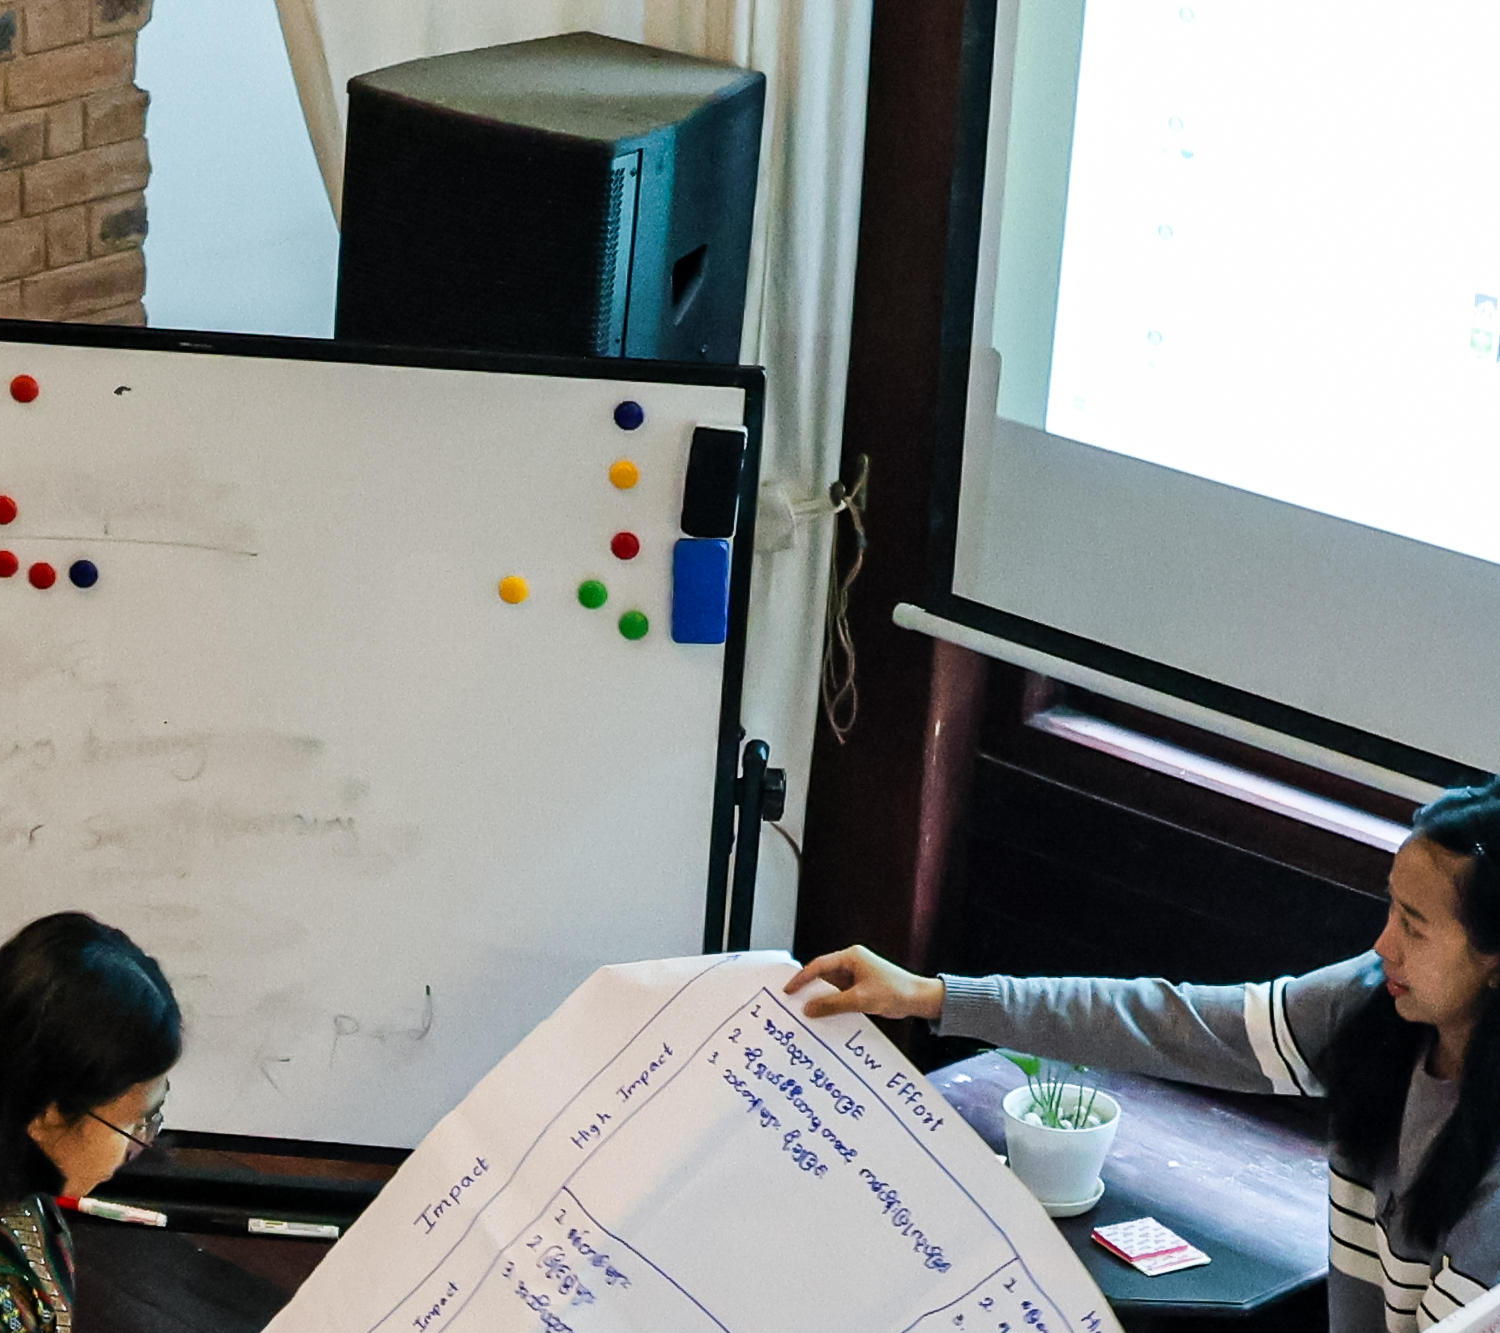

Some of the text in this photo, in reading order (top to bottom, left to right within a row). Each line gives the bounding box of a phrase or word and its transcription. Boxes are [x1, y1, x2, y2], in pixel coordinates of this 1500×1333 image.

[843, 1028, 883, 1071] Low
[412, 1281, 459, 1333] Impact
[569, 1112, 613, 1150] High
[615, 1041, 675, 1103] Impact
[412, 1156, 490, 1236] Impact
